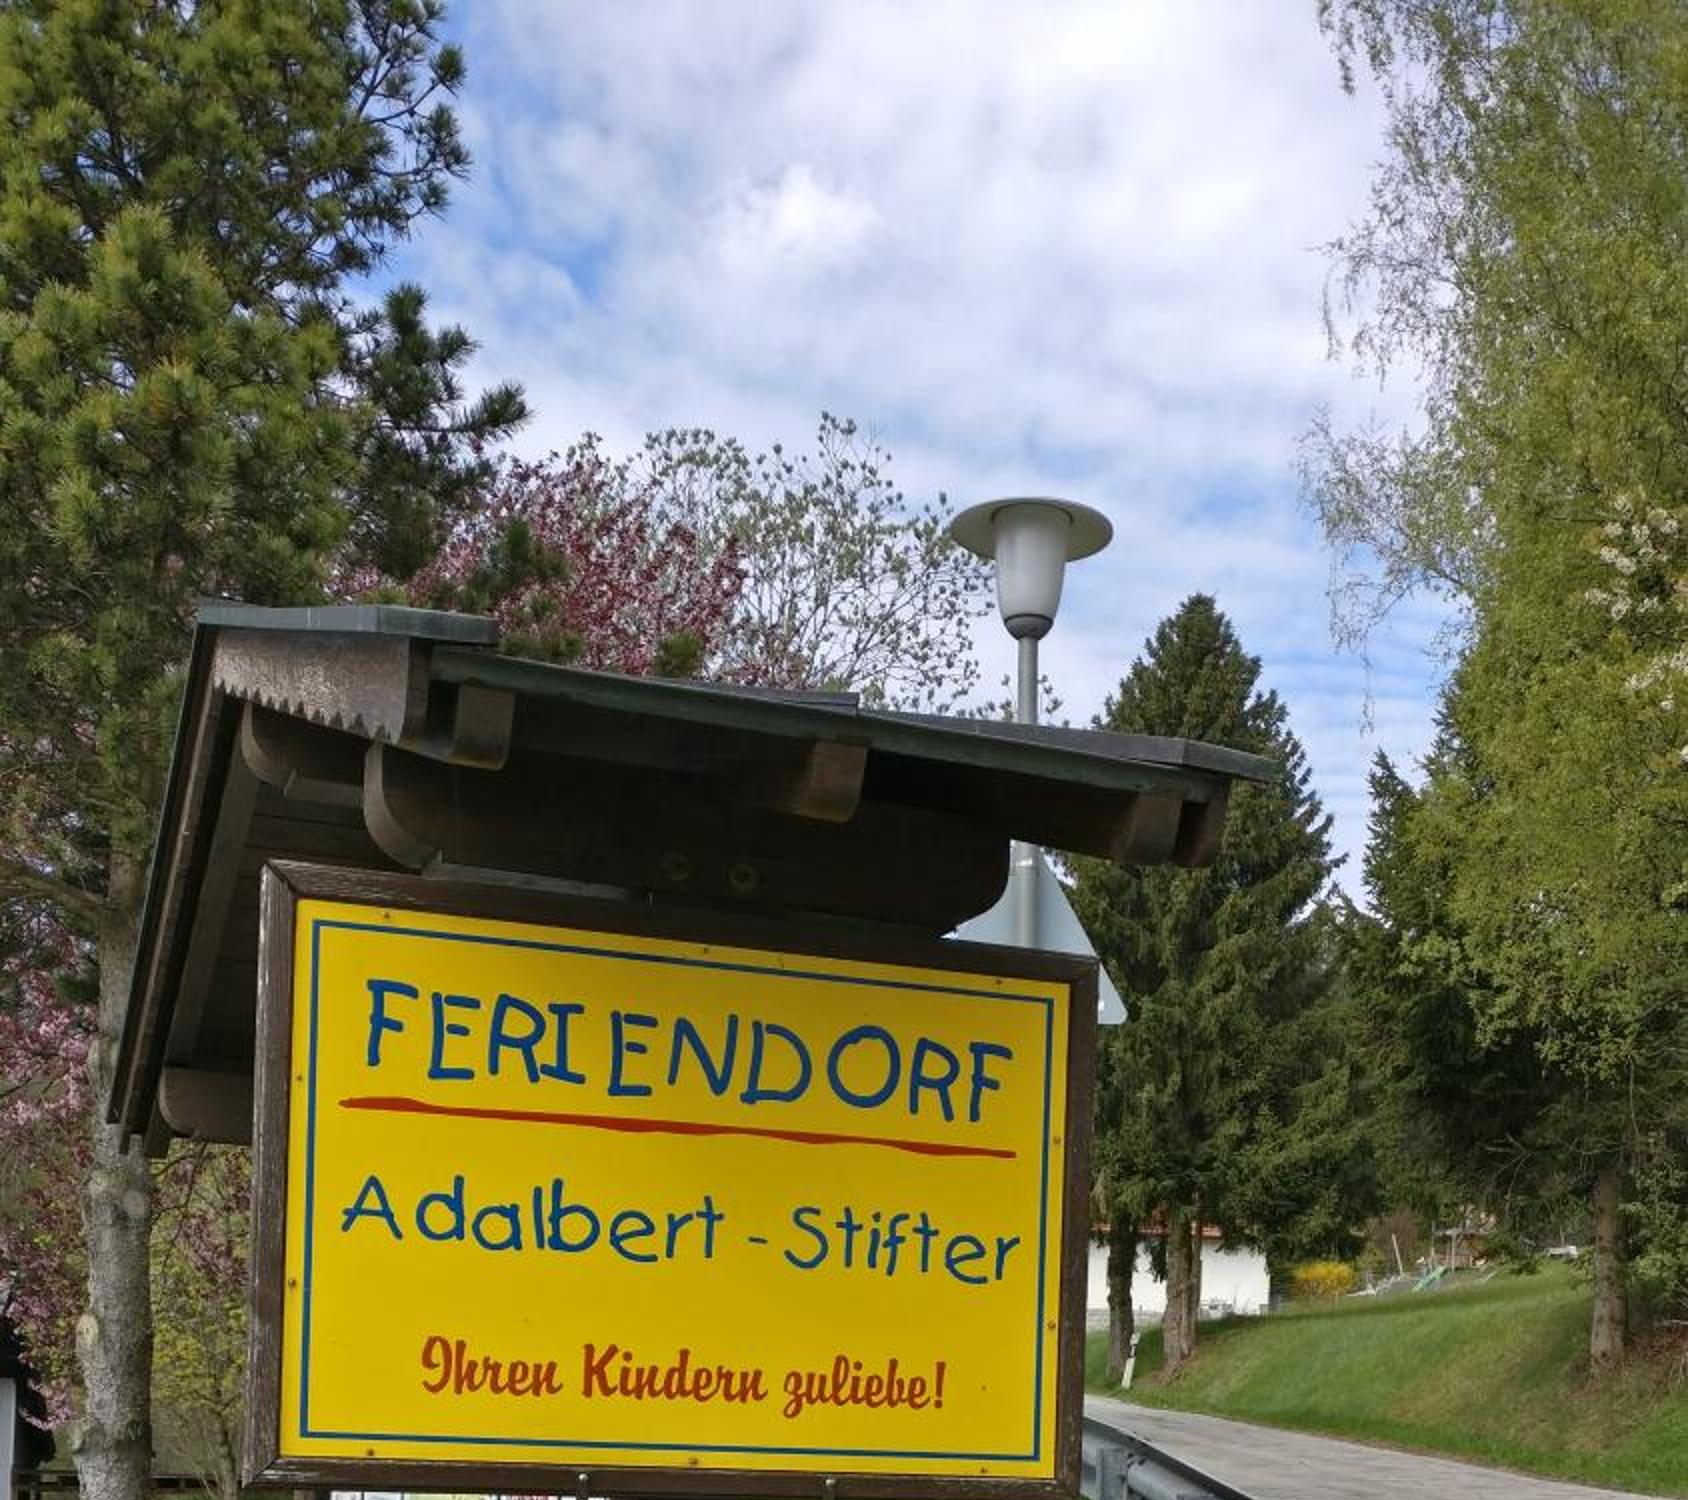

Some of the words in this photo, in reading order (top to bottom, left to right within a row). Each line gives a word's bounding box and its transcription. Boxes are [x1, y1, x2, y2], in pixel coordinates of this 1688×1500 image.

[365, 976, 1014, 1123] FERIENDORF
[421, 1336, 562, 1397] Ihren
[582, 1343, 768, 1403] Kindern
[783, 1355, 946, 1419] zuliebe!
